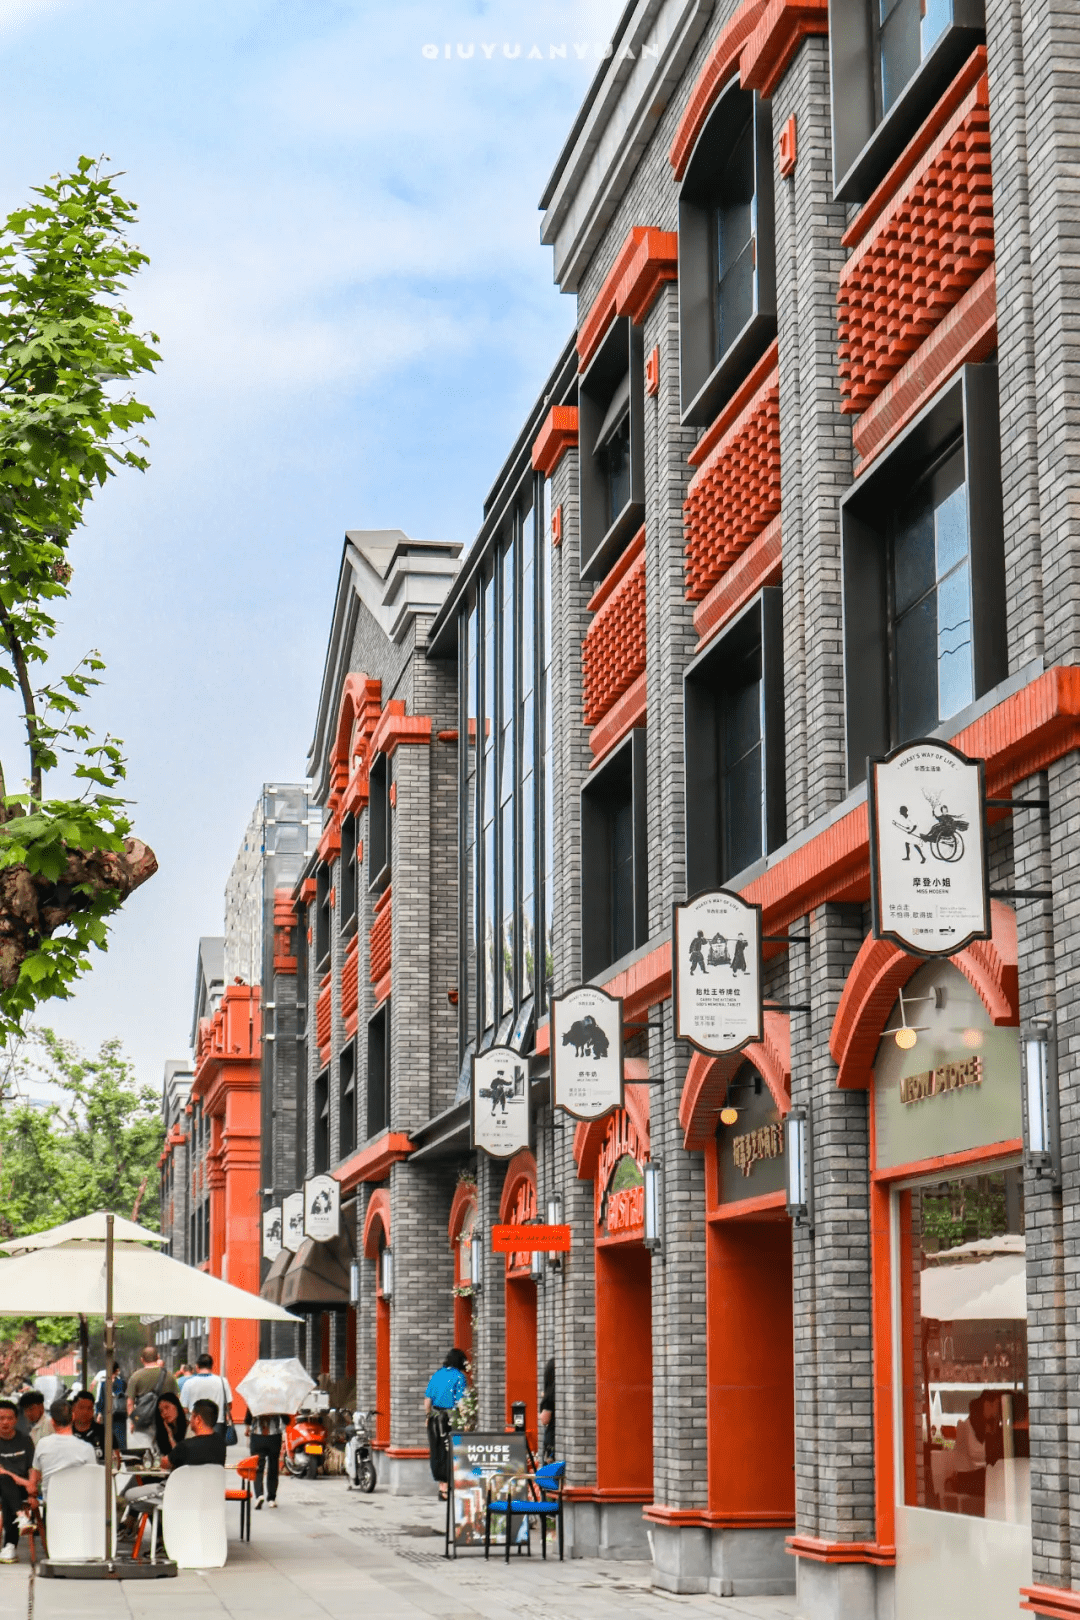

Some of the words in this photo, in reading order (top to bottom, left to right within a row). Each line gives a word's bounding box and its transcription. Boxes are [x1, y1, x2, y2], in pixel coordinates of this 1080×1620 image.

[943, 757, 956, 768] LIFE
[913, 877, 951, 887] 摩登小姐
[467, 1445, 510, 1453] HOUSE
[467, 1454, 510, 1462] WINE
